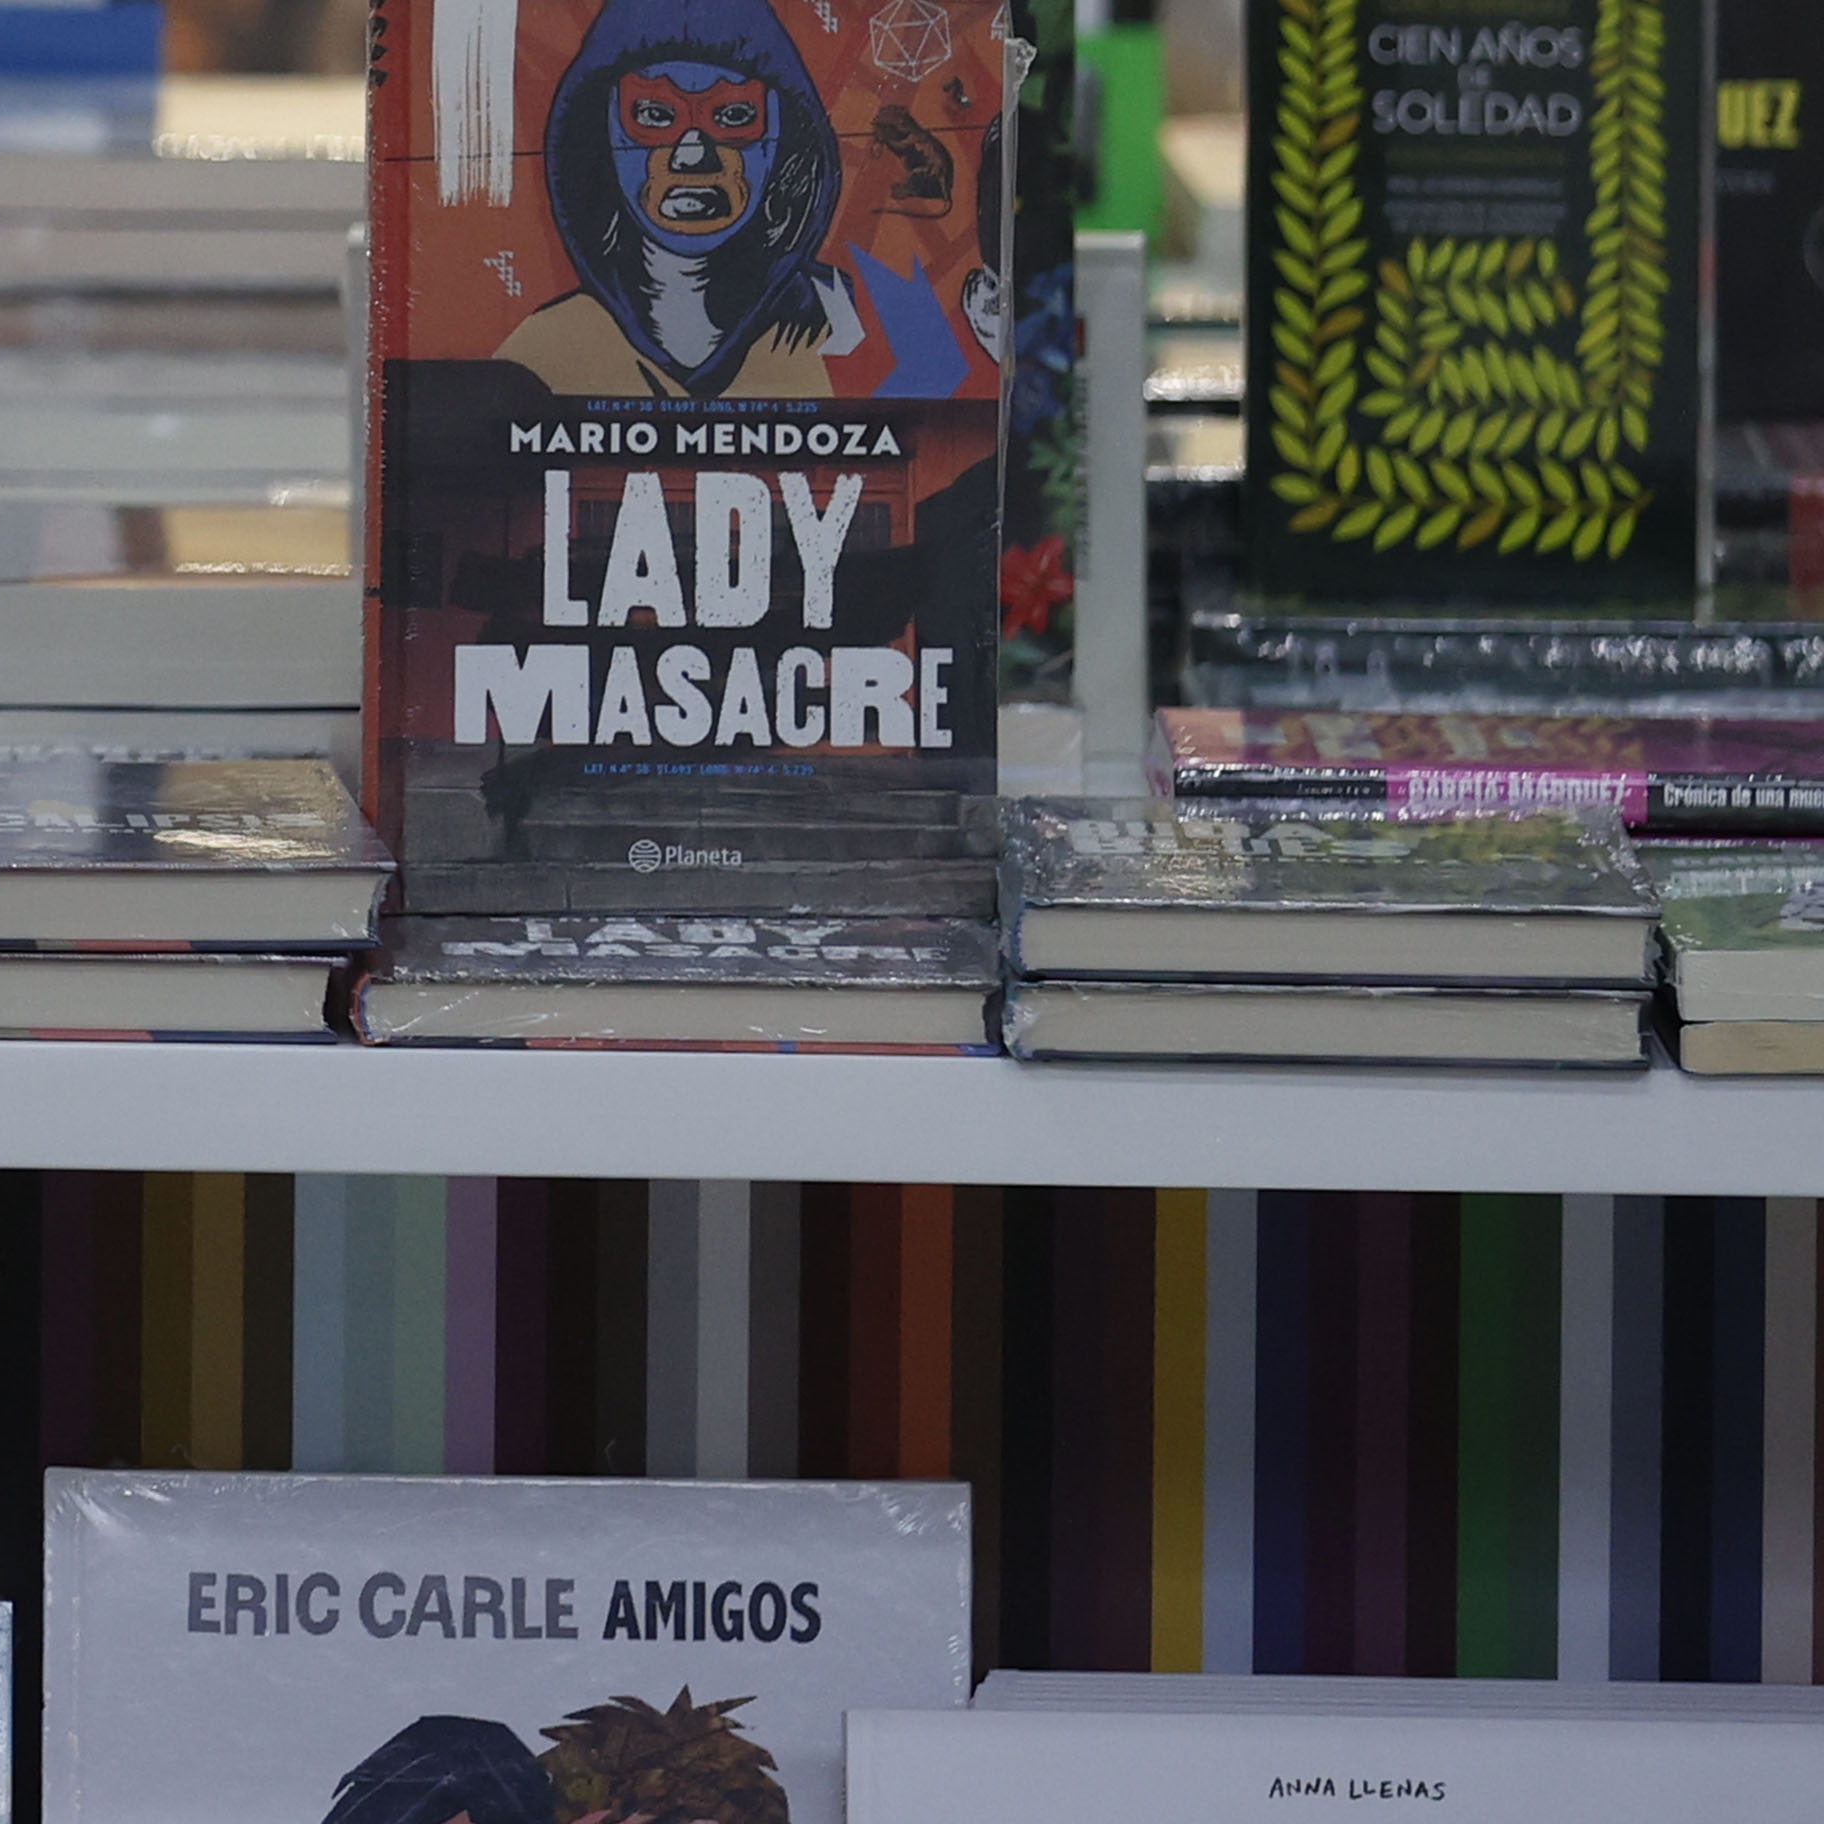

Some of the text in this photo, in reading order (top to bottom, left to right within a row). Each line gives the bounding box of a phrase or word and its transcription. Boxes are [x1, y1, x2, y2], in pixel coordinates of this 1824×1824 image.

[1368, 20, 1585, 69] CIEN AÑOS
[1371, 88, 1583, 137] SOLEDAD
[509, 423, 900, 456] MARIO MENDOZA
[542, 469, 865, 630] LADY
[453, 643, 953, 749] MASACRE
[1663, 782, 1727, 808] Crónica
[1731, 783, 1752, 808] de
[1756, 787, 1785, 808] una
[664, 845, 744, 870] Planeta
[524, 922, 845, 945] LADY
[442, 941, 950, 961] MASACRE
[186, 1571, 822, 1644] ERIC CARLE AMIGOS
[1268, 1776, 1447, 1802] ANNA LLENAS
